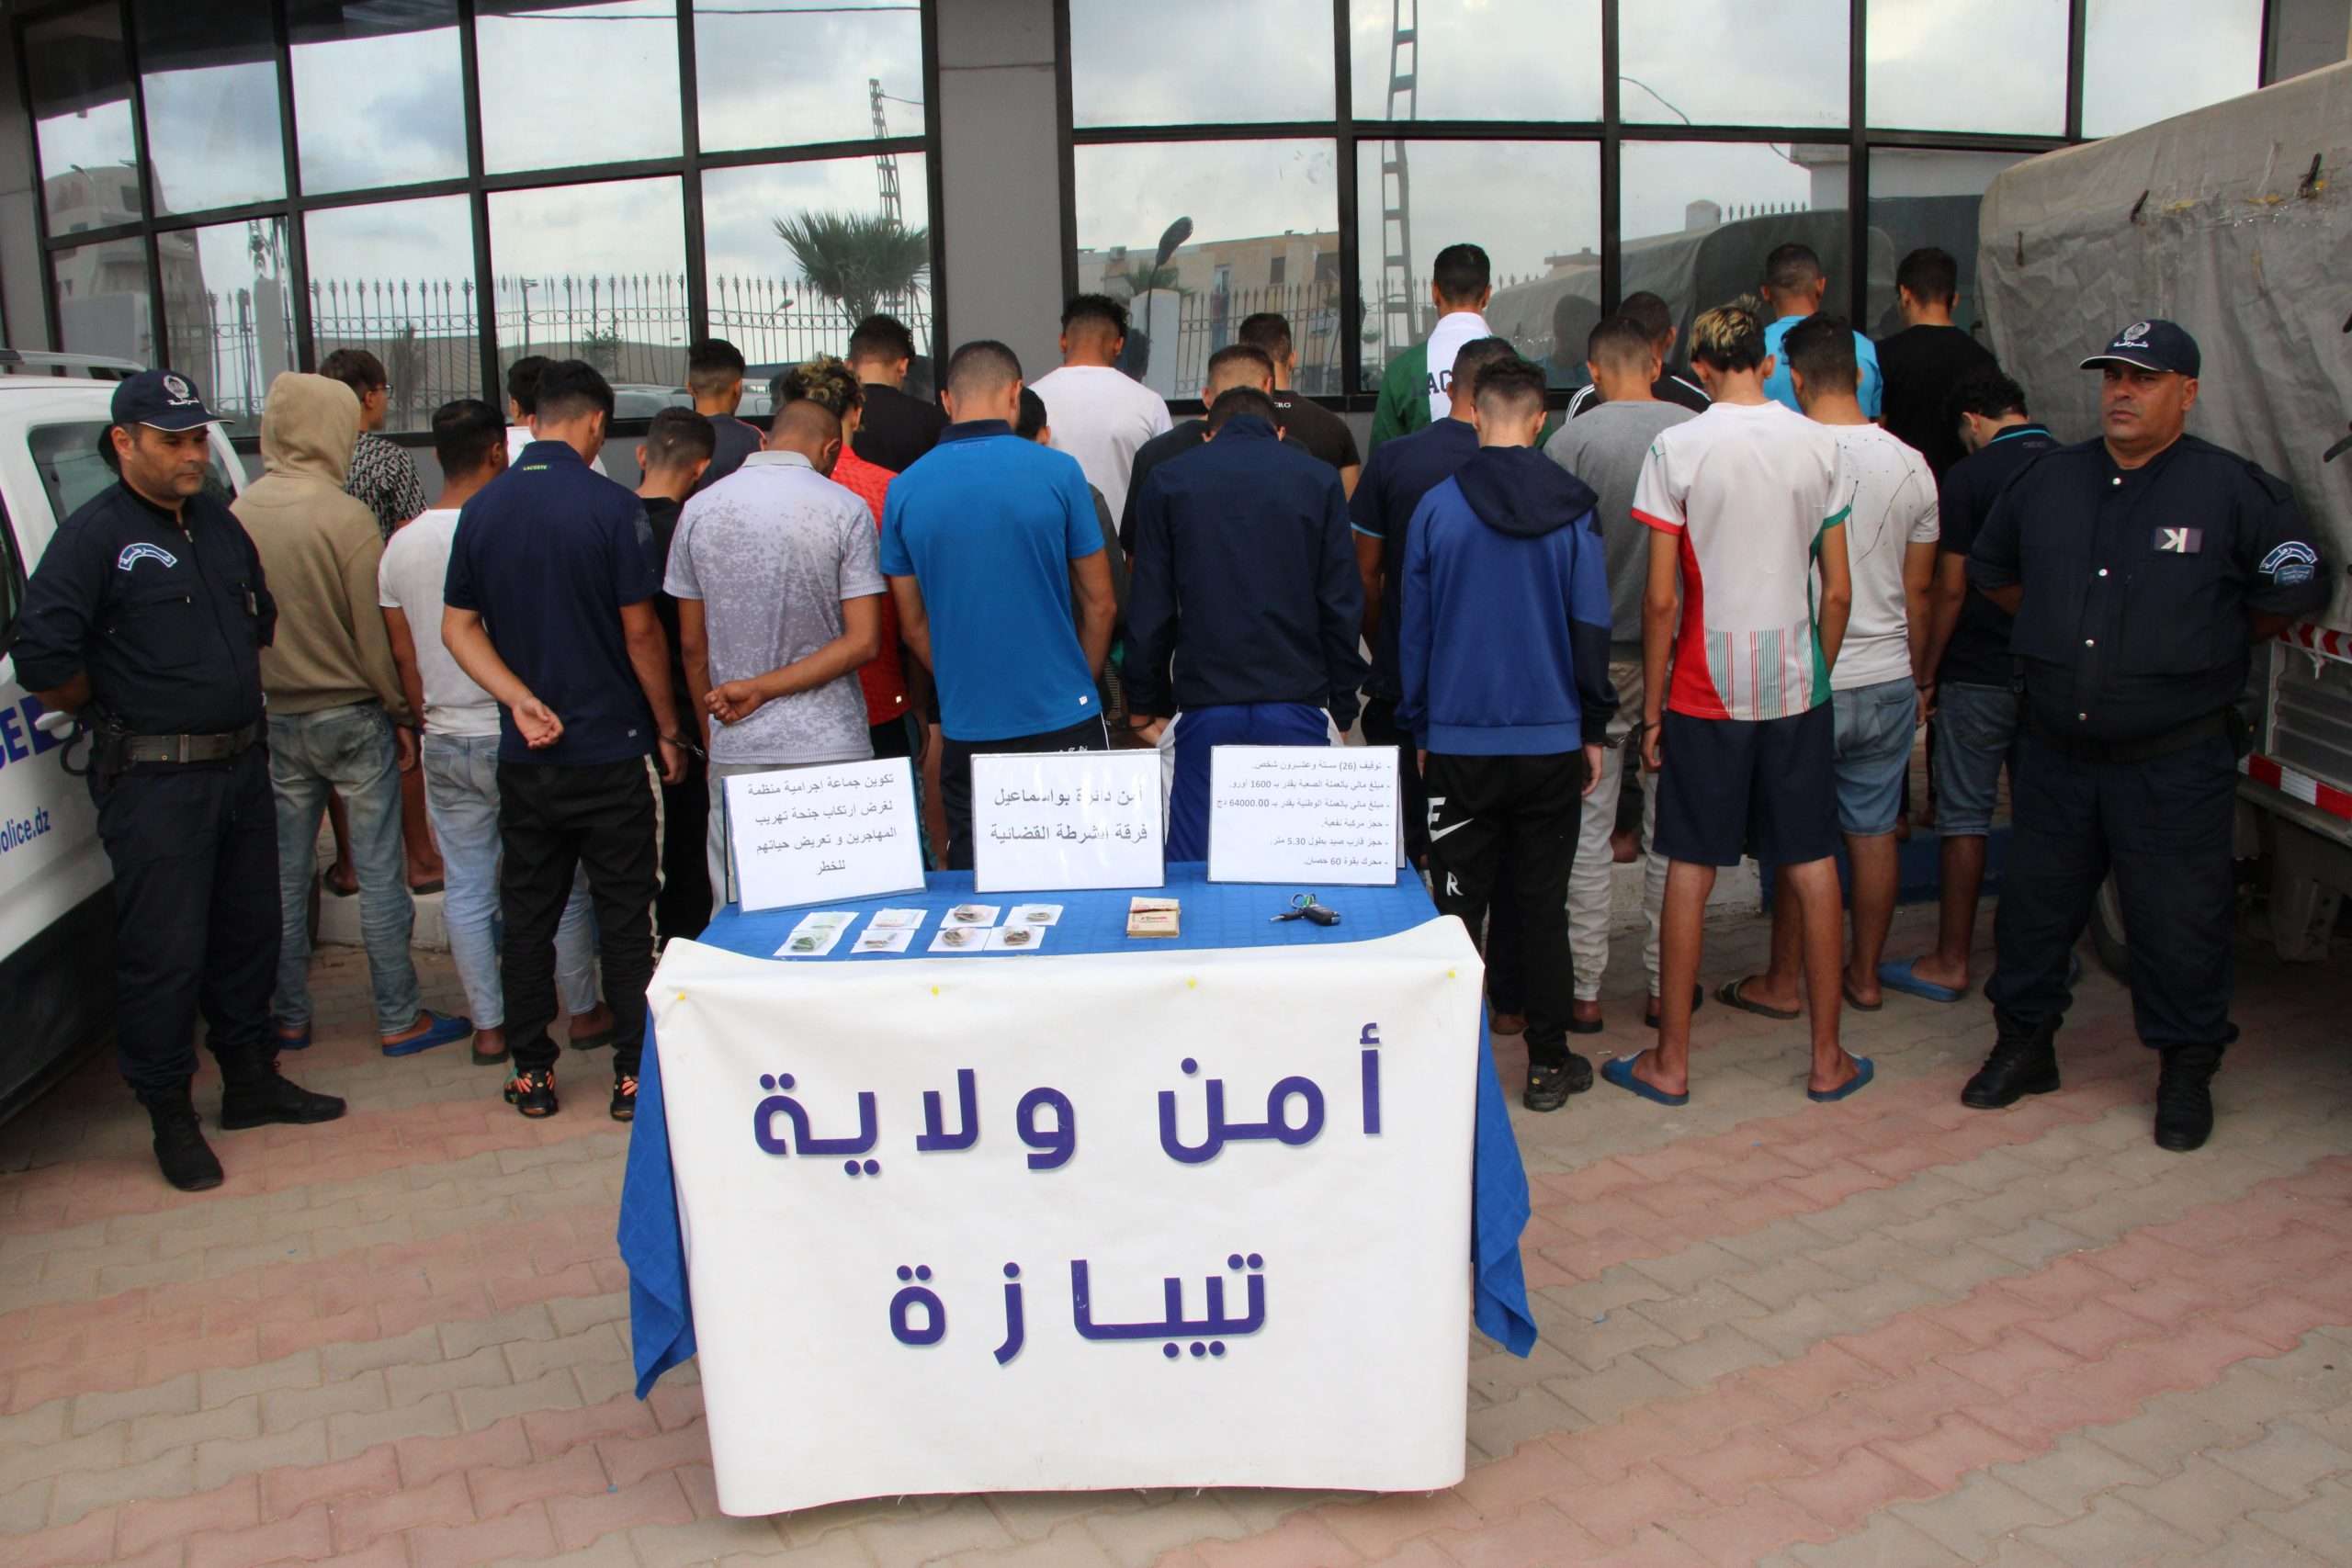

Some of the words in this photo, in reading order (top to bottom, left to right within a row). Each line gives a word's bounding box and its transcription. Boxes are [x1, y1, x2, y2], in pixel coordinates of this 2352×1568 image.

[1339, 761, 1357, 772] (26)
[784, 778, 824, 795] اجرامية
[827, 775, 861, 790] جماعة
[865, 773, 894, 788] تكوين
[1250, 780, 1272, 788] 1600
[1325, 779, 1349, 789] بالعملة
[1350, 780, 1366, 791] مالي
[1369, 781, 1384, 792] مبلغ
[748, 783, 781, 795] منظمة
[822, 801, 856, 819] ارتكاب
[861, 799, 893, 816] لغرض
[1228, 799, 1270, 807] 64000.00
[1325, 798, 1349, 808] بالعملة
[1350, 800, 1366, 810] مالي
[1368, 800, 1384, 812] مبلغ
[755, 810, 788, 826] تهريب
[791, 807, 820, 821] جنحة
[0, 806, 51, 854] olice.dz
[846, 824, 898, 844] المهاجرين
[989, 823, 1050, 844] القضائية
[1115, 823, 1148, 843] فرقة
[756, 839, 790, 855] حياتهم
[794, 833, 831, 850] تعريض
[1287, 837, 1306, 845] 5.30
[817, 859, 846, 875] للخطر
[1330, 856, 1341, 865] 60
[1157, 1022, 1383, 1164] أمن
[753, 1067, 1077, 1177] ولاية
[888, 1252, 1266, 1366] تيبازة
